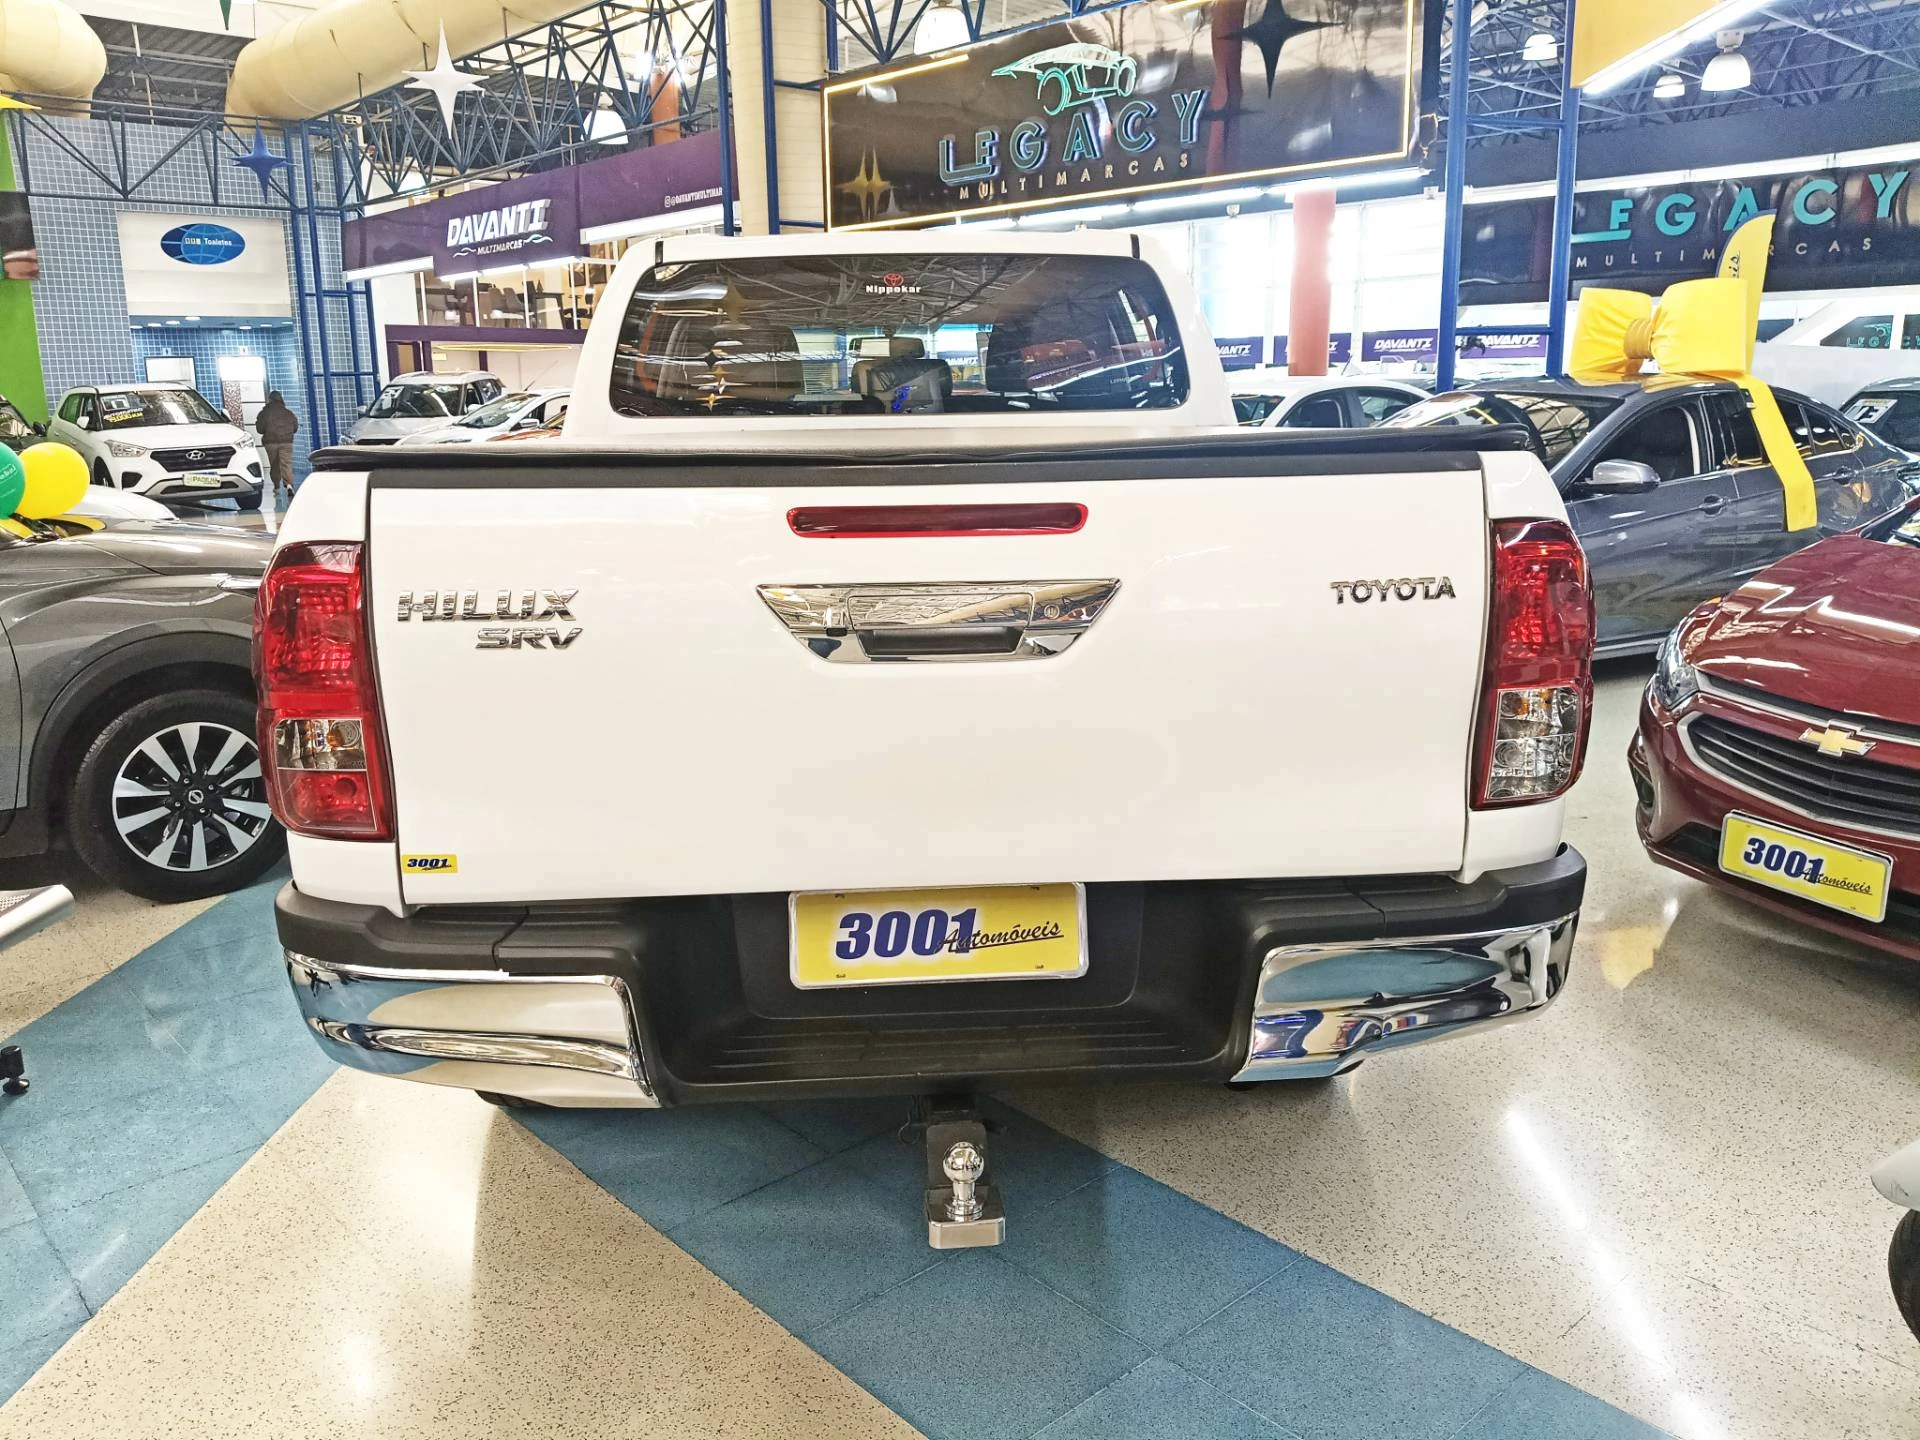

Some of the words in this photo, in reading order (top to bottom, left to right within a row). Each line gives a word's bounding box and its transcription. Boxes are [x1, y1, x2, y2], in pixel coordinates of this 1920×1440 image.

[938, 90, 1207, 184] LEGACY
[959, 152, 1188, 200] MULTIMARCAS
[446, 199, 551, 248] DAVANTI
[477, 240, 523, 255] MULTIMARCAS
[1576, 237, 1872, 268] MULTIMRCAS
[1374, 338, 1434, 349] DAVANTI
[398, 589, 579, 622] HILUX
[1330, 576, 1456, 604] TOYOTA
[475, 627, 583, 649] SRV
[406, 858, 448, 868] 3001
[1743, 837, 1824, 884] 3001
[835, 908, 977, 960] 3001
[936, 921, 1064, 953] Automóveis
